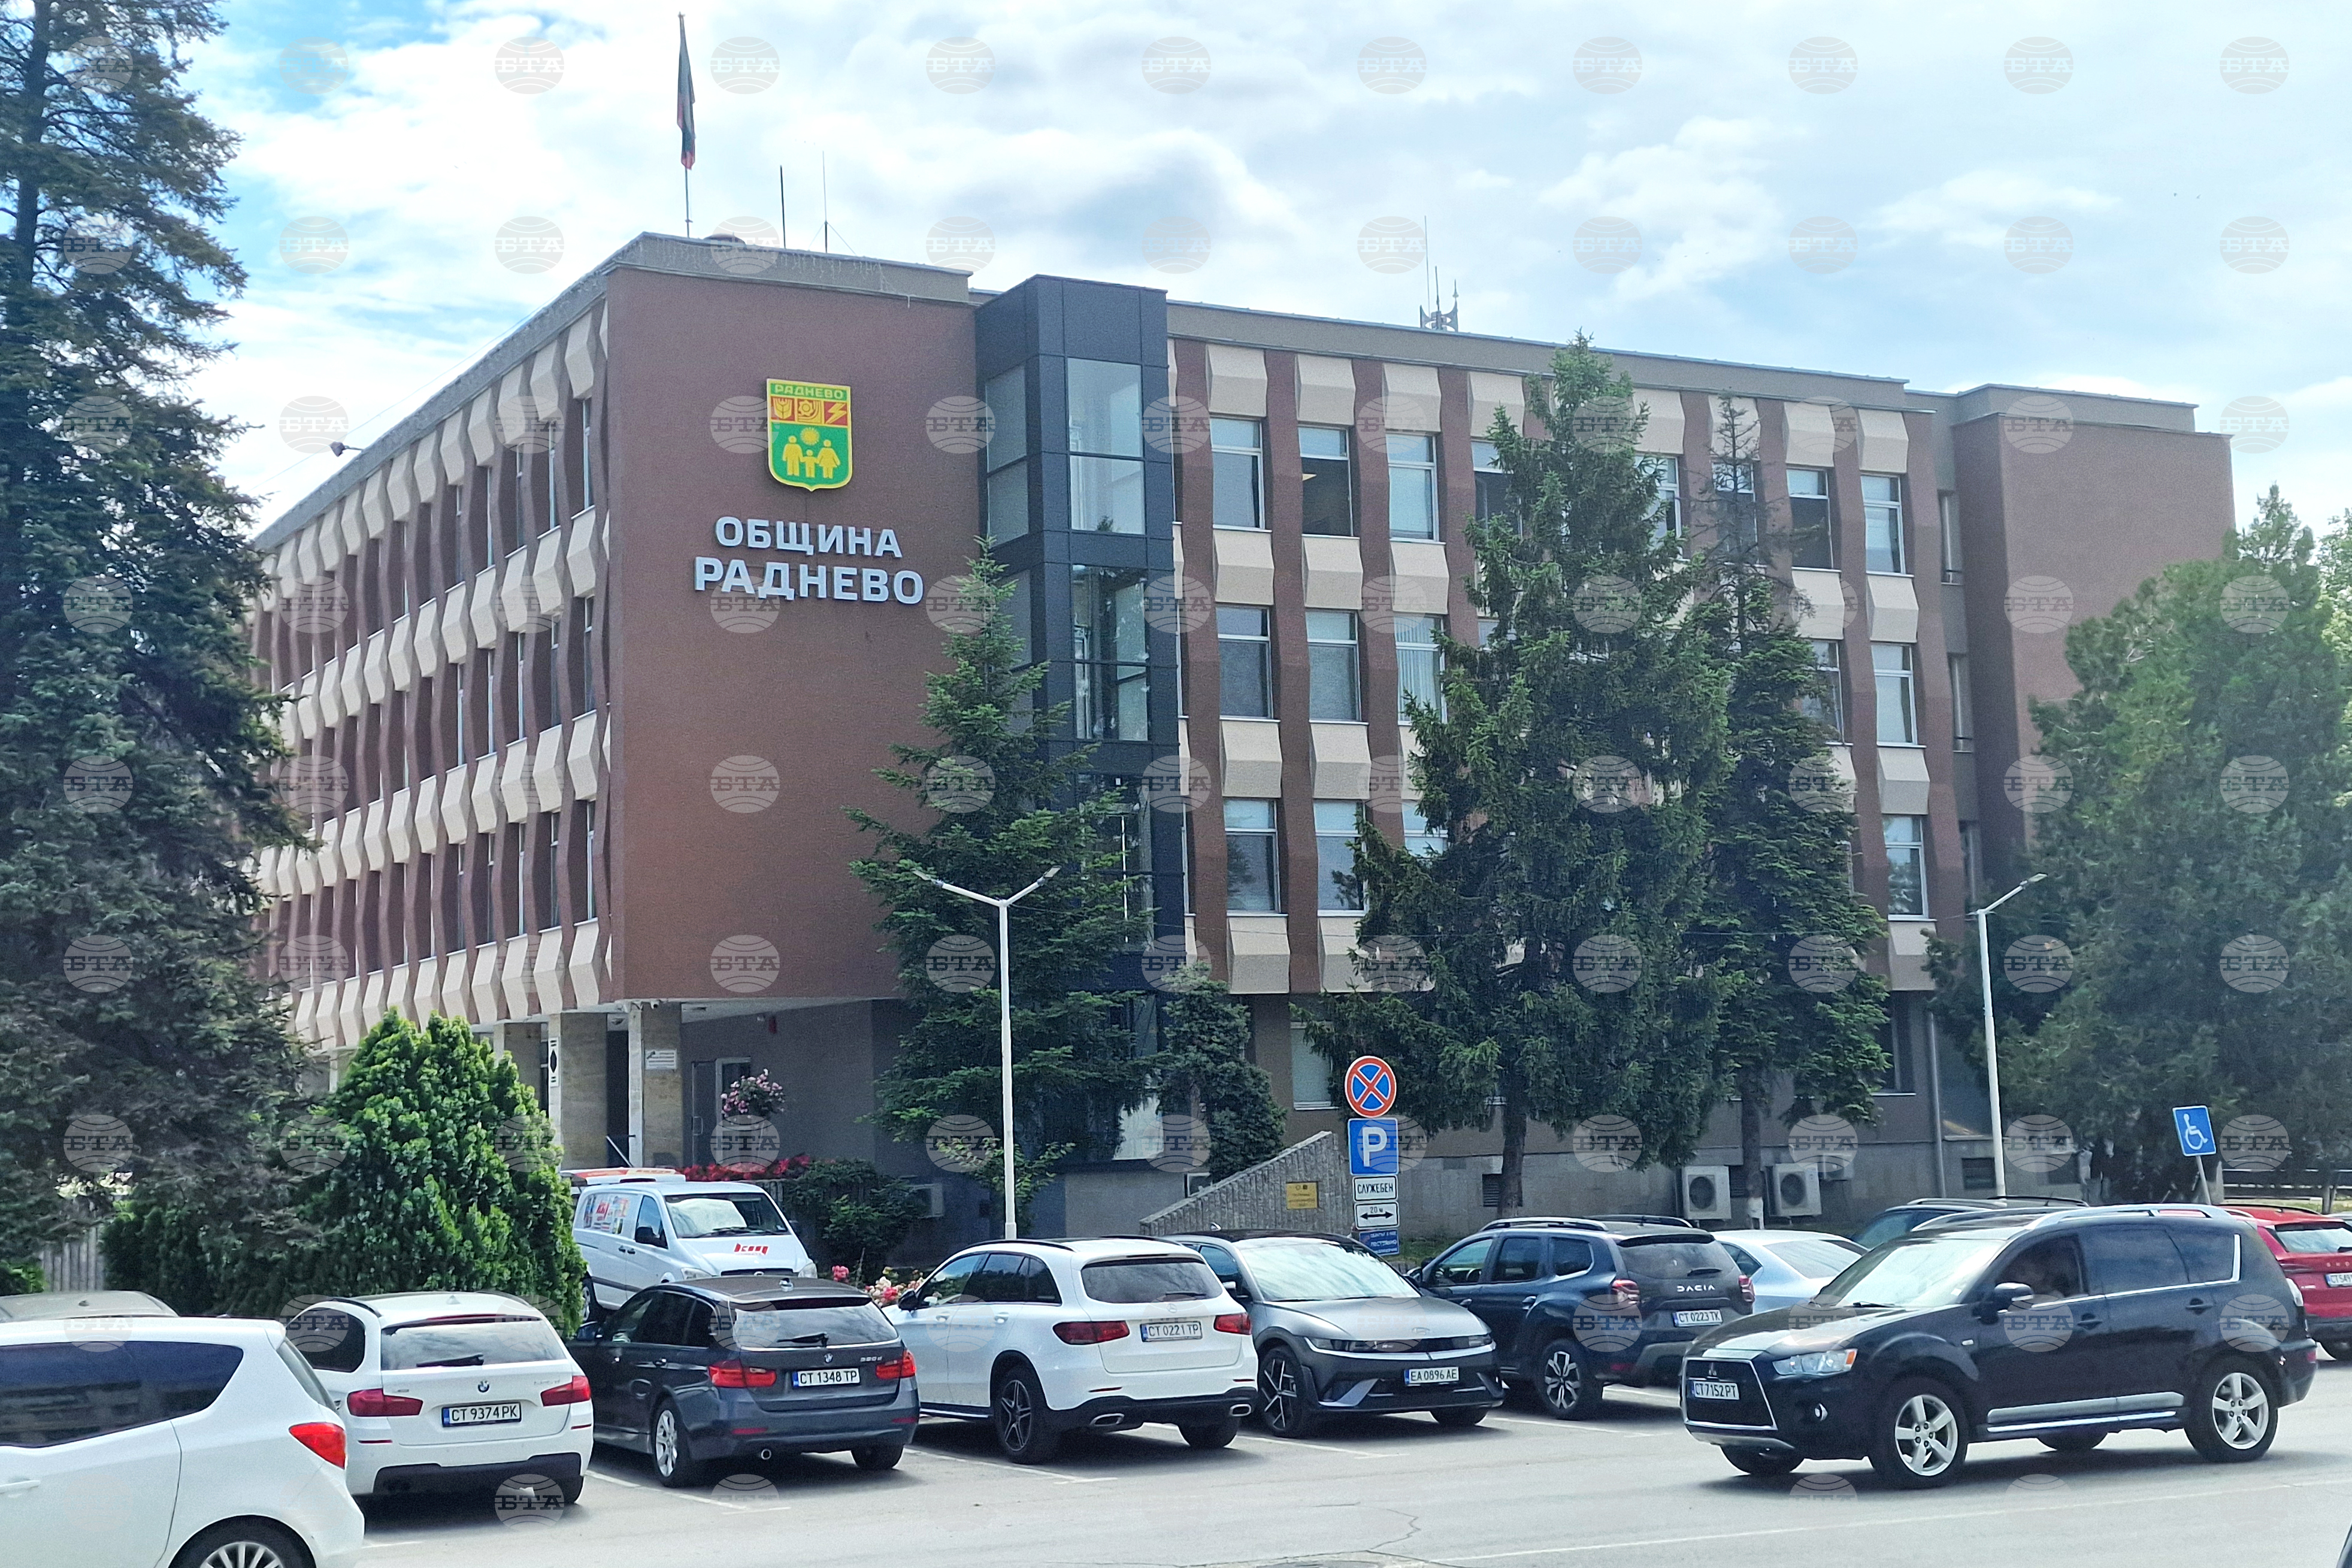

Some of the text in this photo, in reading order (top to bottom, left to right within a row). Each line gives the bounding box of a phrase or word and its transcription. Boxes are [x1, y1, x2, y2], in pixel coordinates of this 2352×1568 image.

[774, 385, 844, 399] РАДНЕВО
[716, 516, 902, 558] ОБЩИНА
[695, 556, 924, 605] РАДНЕВО
[1363, 1127, 1387, 1167] P
[1357, 1183, 1394, 1194] СЛУЖЕБЕН
[1691, 1312, 1709, 1322] 0223
[1148, 1324, 1198, 1336] CT 0221 TP
[800, 1370, 857, 1384] CT 1348 TP
[1410, 1369, 1457, 1381] EA 0896 AE
[451, 1405, 517, 1421] CT 9374 PK
